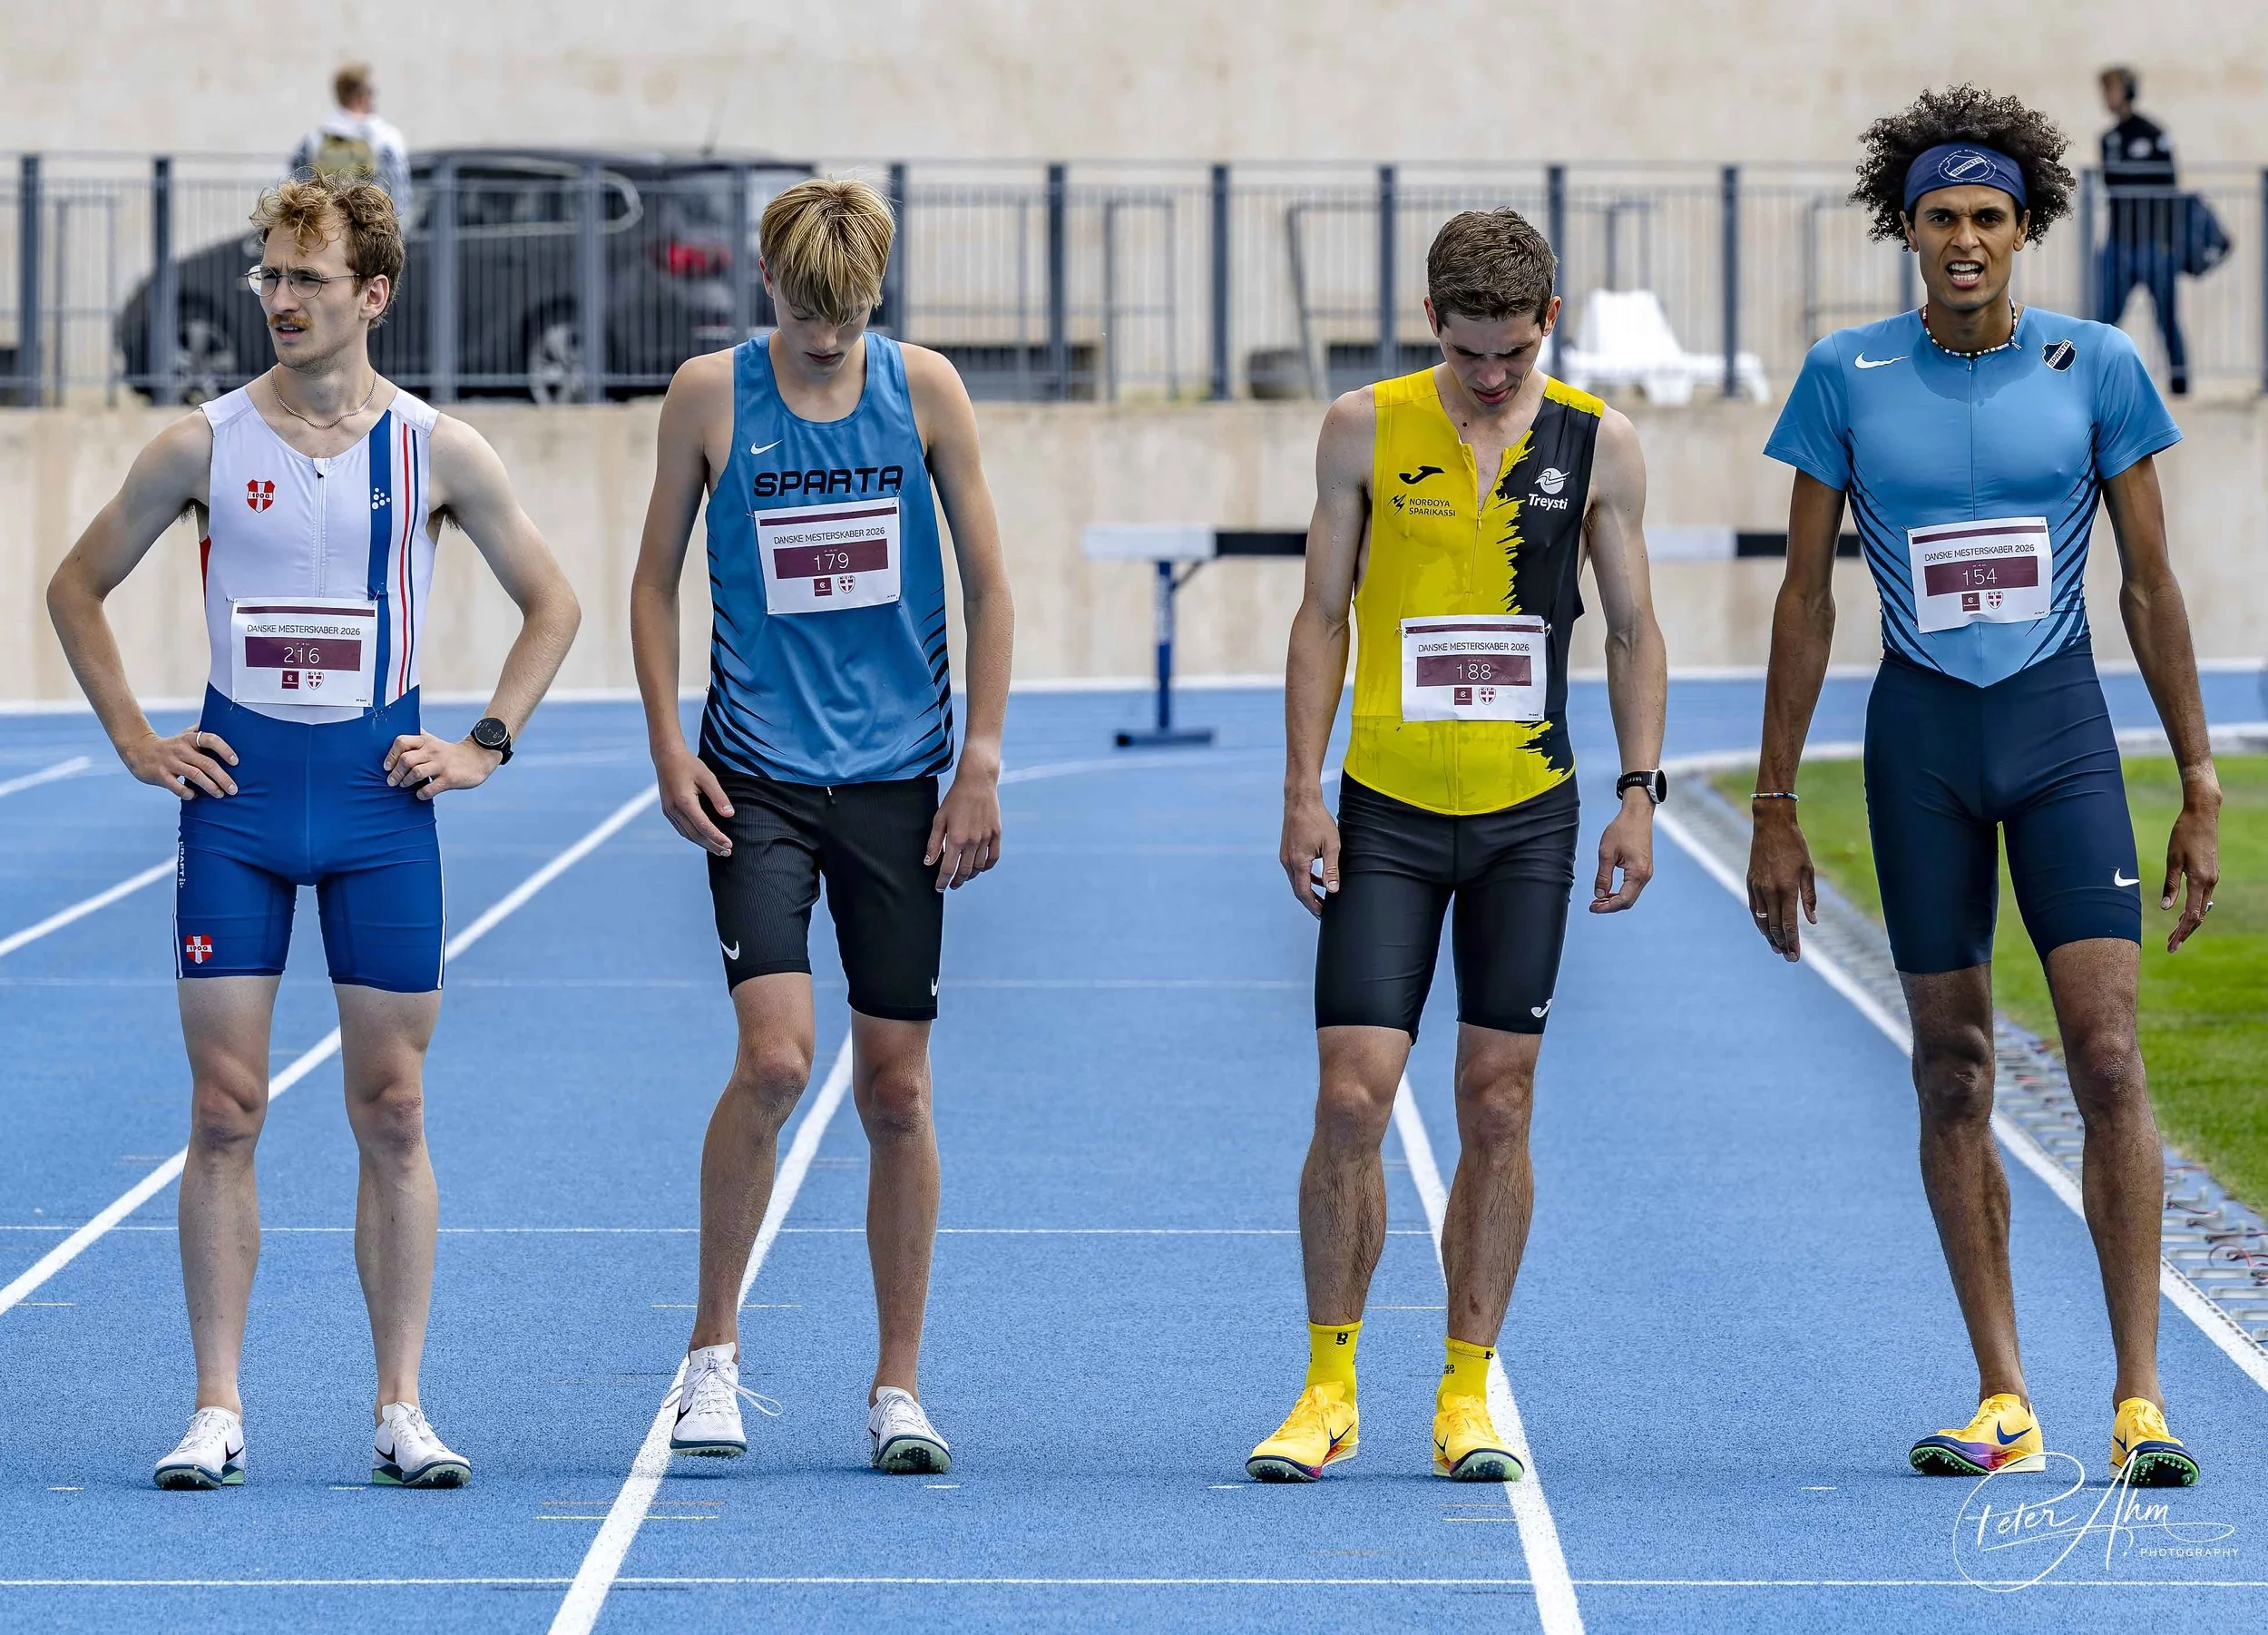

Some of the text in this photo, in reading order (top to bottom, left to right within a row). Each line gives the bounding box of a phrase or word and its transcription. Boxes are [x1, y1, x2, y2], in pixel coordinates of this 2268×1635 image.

[2048, 341, 2070, 367] SPARTA
[754, 465, 904, 497] SPARTA
[1528, 493, 1569, 511] Treysti
[1409, 507, 1456, 517] SPARIKASSI
[774, 527, 885, 544] DANSKE MESTERSKABER 2026
[814, 552, 849, 571] 179
[1924, 543, 2035, 562] DANSKE MESTERSKABER 2026
[1962, 568, 1998, 586] 154
[247, 624, 361, 636] DANSKE MESTERSKABER 2026
[284, 646, 320, 664] 216
[1418, 642, 1530, 652] DANSKE MESTERSKABER 2026
[1456, 663, 1491, 680] 188
